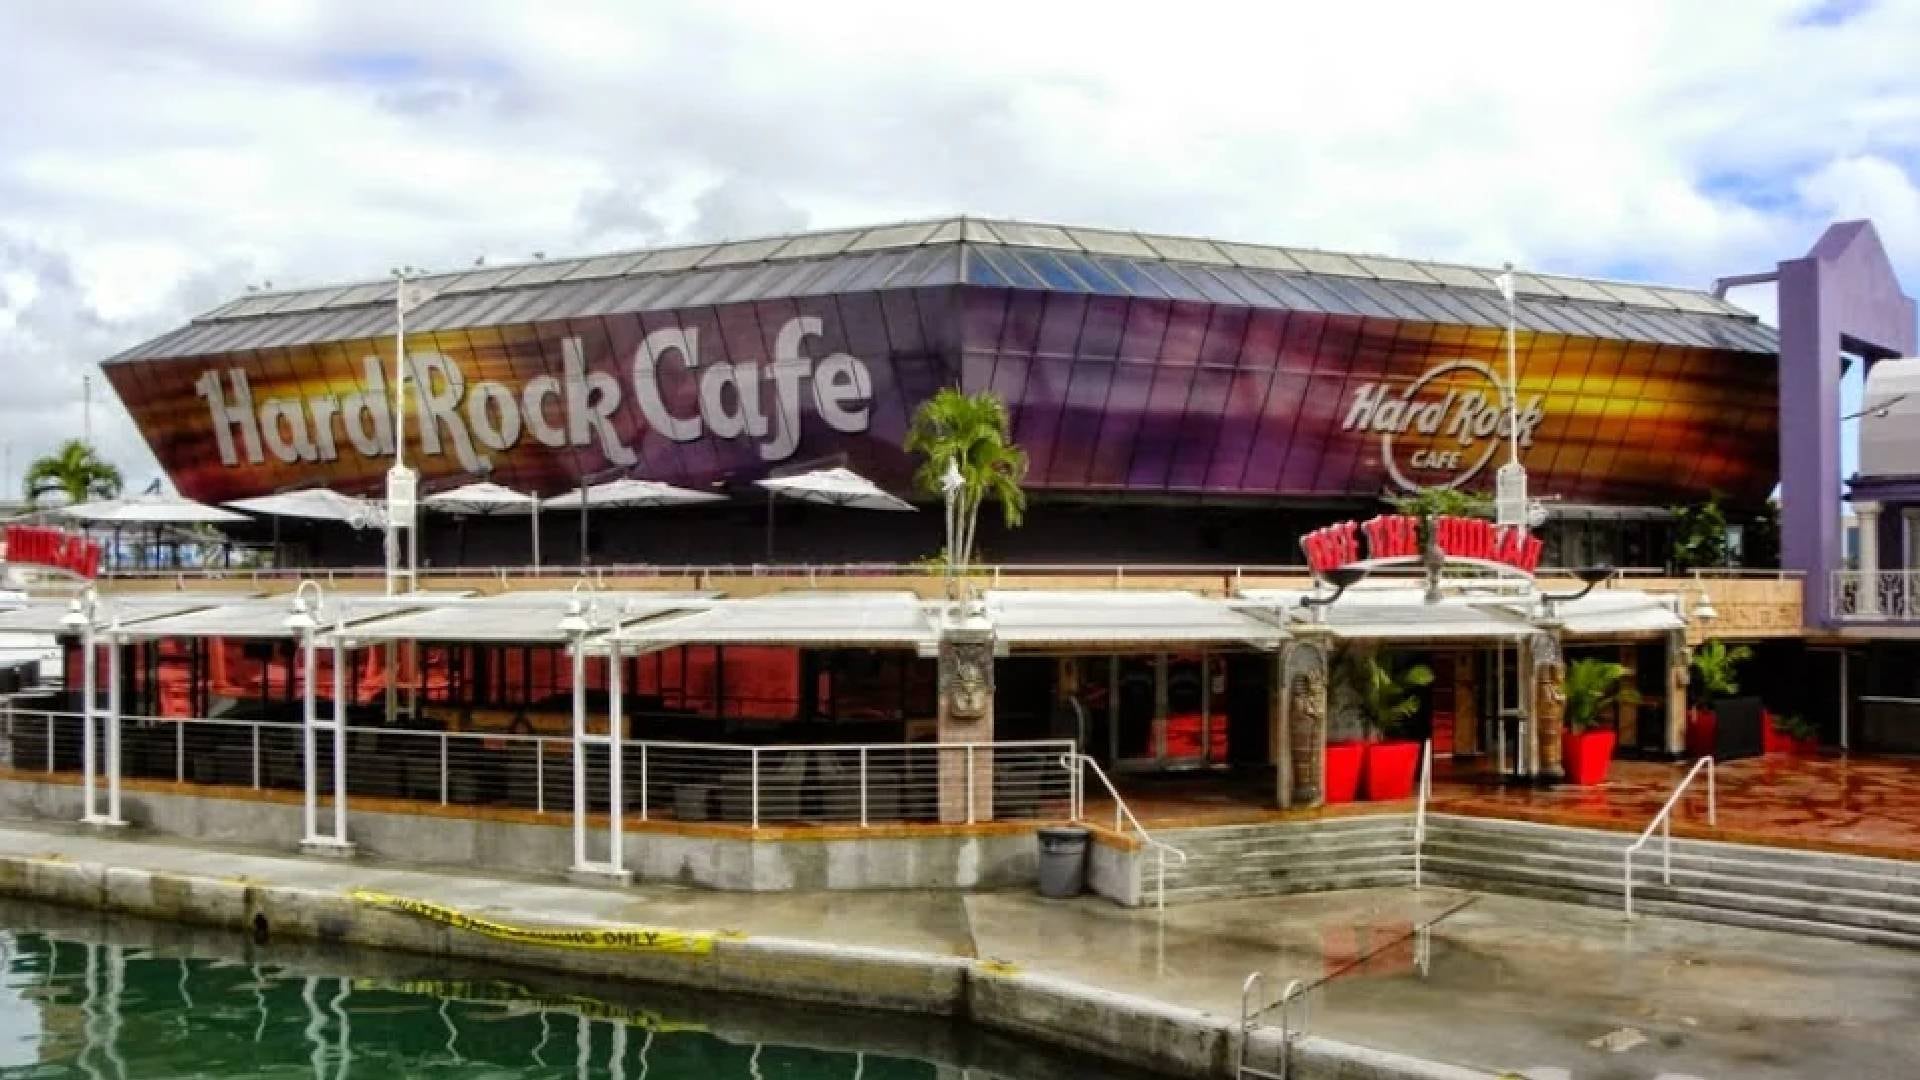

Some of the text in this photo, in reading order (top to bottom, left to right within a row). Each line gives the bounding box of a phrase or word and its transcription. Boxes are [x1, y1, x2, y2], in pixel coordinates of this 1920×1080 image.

[196, 316, 873, 473] Hard Rock Cafe
[1342, 382, 1545, 449] Hard Rock
[1411, 450, 1462, 470] CAFE
[602, 930, 659, 946] ONLY
